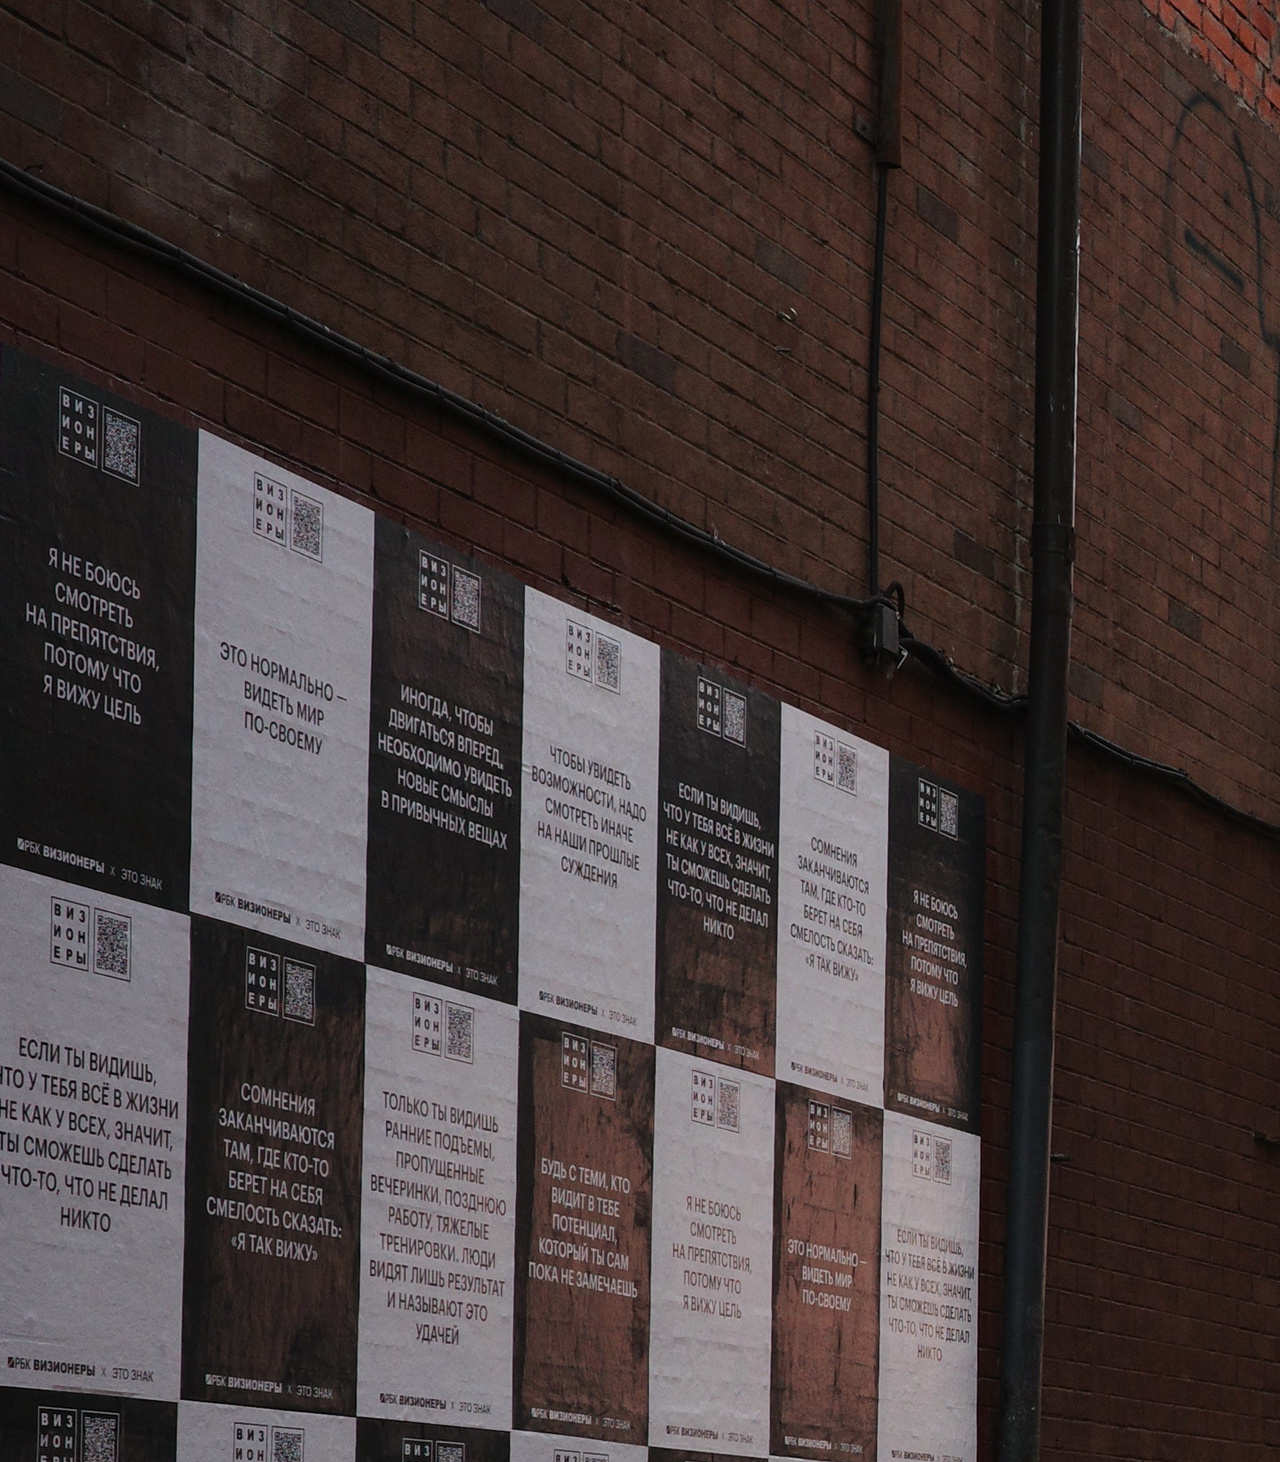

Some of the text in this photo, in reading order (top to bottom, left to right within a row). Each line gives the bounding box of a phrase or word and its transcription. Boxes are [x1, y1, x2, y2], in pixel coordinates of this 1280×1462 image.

[48, 547, 141, 600] Я НЕ БОЮСЬ
[55, 582, 133, 628] СМОТРЕТЬ
[26, 602, 160, 672] НА ПРЕПЯТСТВИЯ,
[44, 641, 142, 694] ПОТОМУ ЧТО
[220, 641, 248, 668] ЭТО
[250, 653, 334, 702] НОРМАЛЬНО
[43, 674, 142, 726] Я ВИЖУ ЦЕЛЬ
[244, 680, 325, 726] ВИДЕТЬ МИР
[400, 684, 494, 737] ИНОГДА, ЧТОБЫ
[244, 710, 323, 755] ПО-СВОЕМУ
[388, 707, 455, 749] ДВИГАТЬСЯ
[378, 732, 513, 798] НЕОБХОДИМО УВИДЕТЬ
[549, 745, 631, 791] ЧТОБЫ УВИДЕТЬ
[397, 767, 494, 818] НОВЫЕ СМЫСЛЫ
[531, 765, 647, 823] ВОЗМОЖНОСТИ, НАДО
[381, 789, 508, 851] В ПРИВЫЧНЫХ ВЕЩАХ
[545, 797, 634, 844] СМОТРЕТЬ ИНАЧЕ
[537, 820, 640, 872] НА НАШИ ПРОШЛЫЕ
[810, 836, 858, 868] СОМНЕНИЯ
[560, 855, 618, 889] СУЖДЕНИЯ
[797, 854, 869, 895] ЗАКАНЧИВАЮТСЯ
[800, 878, 866, 917] ТАМ, ГДЕ КТО-ТО
[803, 904, 863, 938] БЕРЕТ НА СЕБЯ
[790, 923, 874, 966] СМЕЛОСТЬ СКАЗАТЬ:
[805, 953, 859, 982] «Я ТАК ВИЖУ»
[240, 1082, 316, 1117] СОМНЕНИЯ
[382, 1090, 499, 1134] ТОЛЬКО ТЫ ВИДИШЬ
[218, 1107, 335, 1150] ЗАКАНЧИВАЮТСЯ
[385, 1119, 495, 1162] РАННИЕ ПОДЪЕМЫ,
[223, 1138, 330, 1178] ТАМ, ГДЕ КТО-ТО
[395, 1150, 485, 1185] ПРОПУЩЕННЫЕ
[228, 1169, 323, 1206] БЕРЕТ НА СЕБЯ
[370, 1173, 507, 1216] ВЕЧЕРИНКИ, ПОЗДНЮЮ
[206, 1196, 342, 1238] СМЕЛОСТЬ СКАЗАТЬ:
[388, 1205, 490, 1241] РАБОТУ, ТЯЖЕЛЫЕ
[231, 1232, 318, 1262] «Я ТАК ВИЖУ»
[379, 1232, 496, 1270] ТРЕНИРОВКИ. ЛЮДИ
[369, 1259, 506, 1297] ВИДЯТ ЛИШЬ РЕЗУЛЬТАТ
[387, 1291, 488, 1322] И НАЗЫВАЮТ ЭТО
[415, 1323, 460, 1345] УДАЧЕЙ
